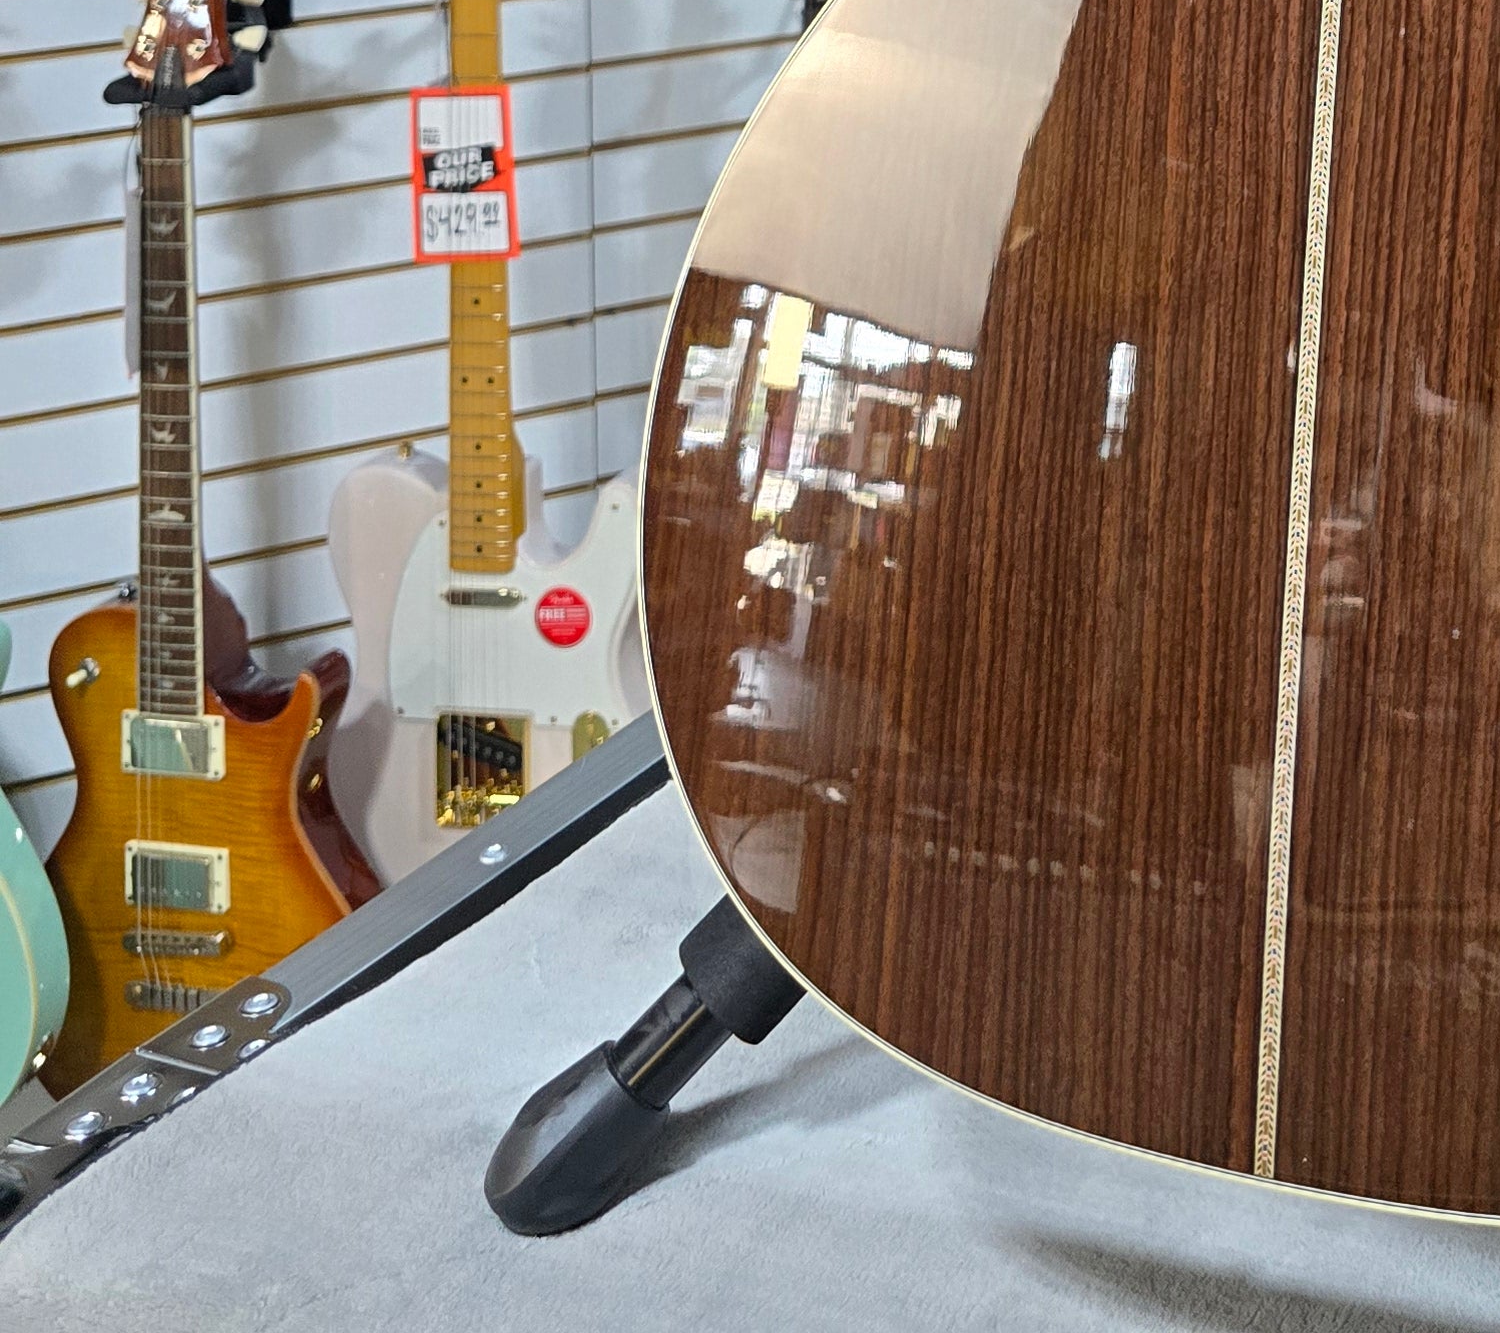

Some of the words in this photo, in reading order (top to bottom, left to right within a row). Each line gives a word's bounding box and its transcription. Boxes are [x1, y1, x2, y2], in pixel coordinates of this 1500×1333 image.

[434, 147, 482, 169] OUR
[428, 161, 495, 191] PRICE
[539, 608, 566, 622] FREE
